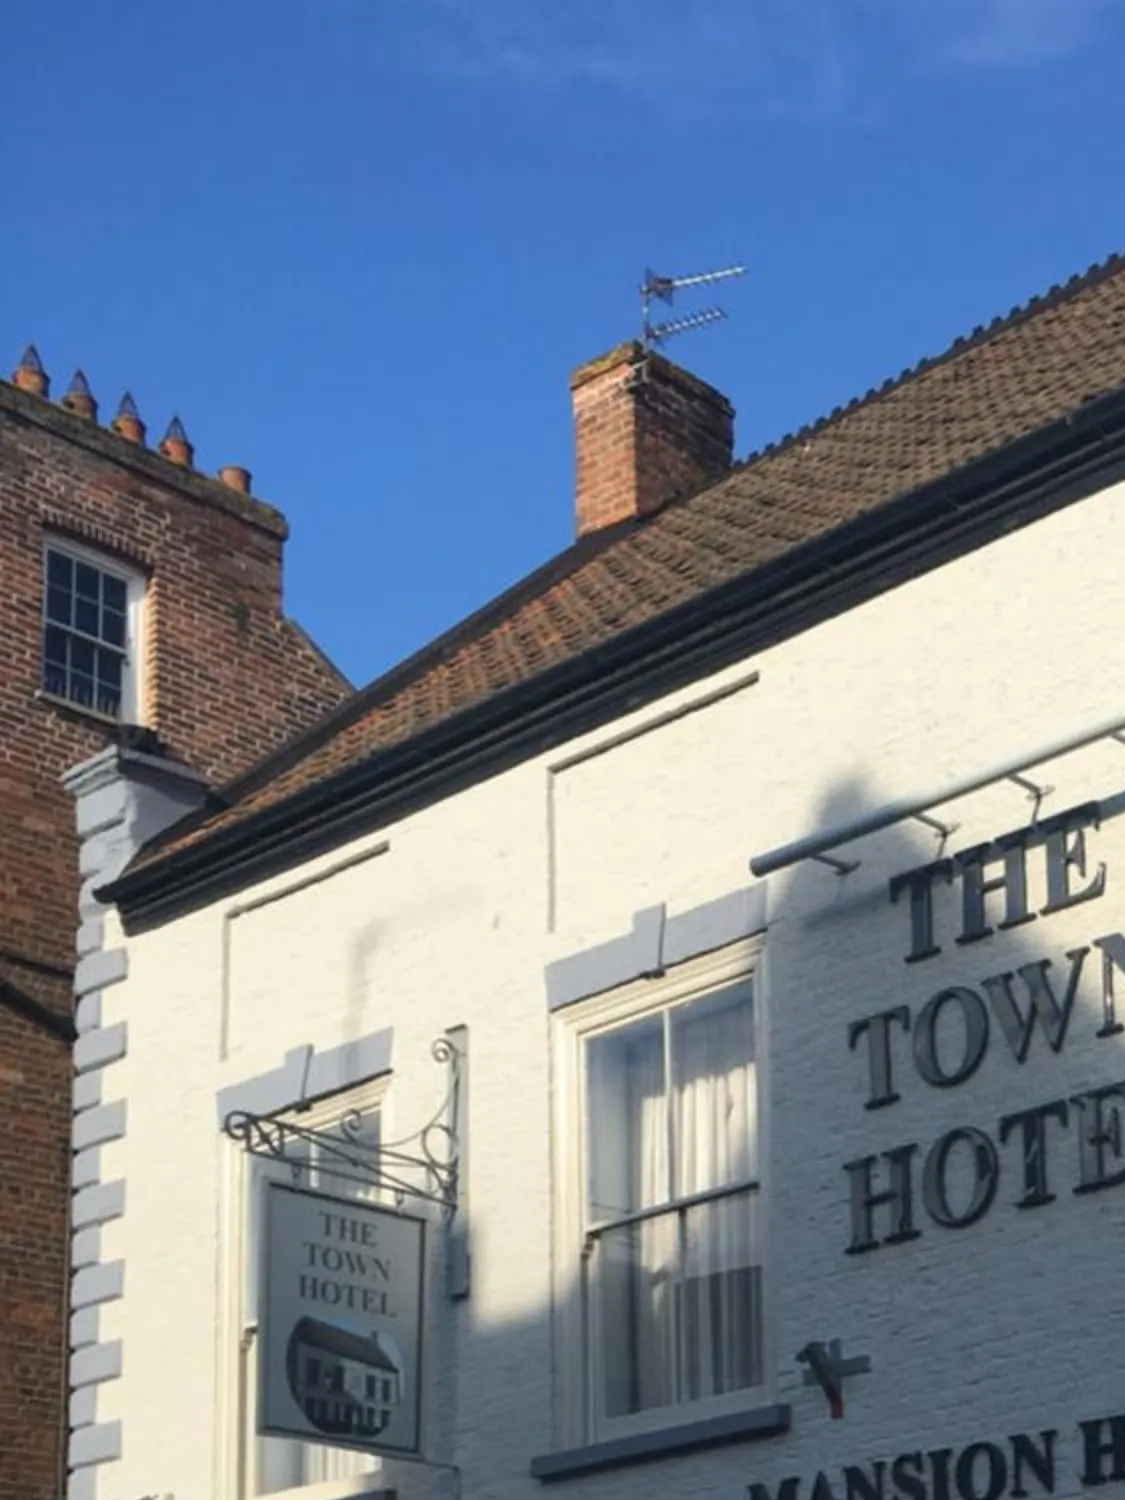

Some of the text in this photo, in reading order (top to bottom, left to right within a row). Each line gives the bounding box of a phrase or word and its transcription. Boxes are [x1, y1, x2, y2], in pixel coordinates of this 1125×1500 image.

[890, 800, 1106, 964] THE
[319, 1211, 378, 1248] THE
[303, 1242, 391, 1283] TOWN
[298, 1273, 397, 1318] HOTEL
